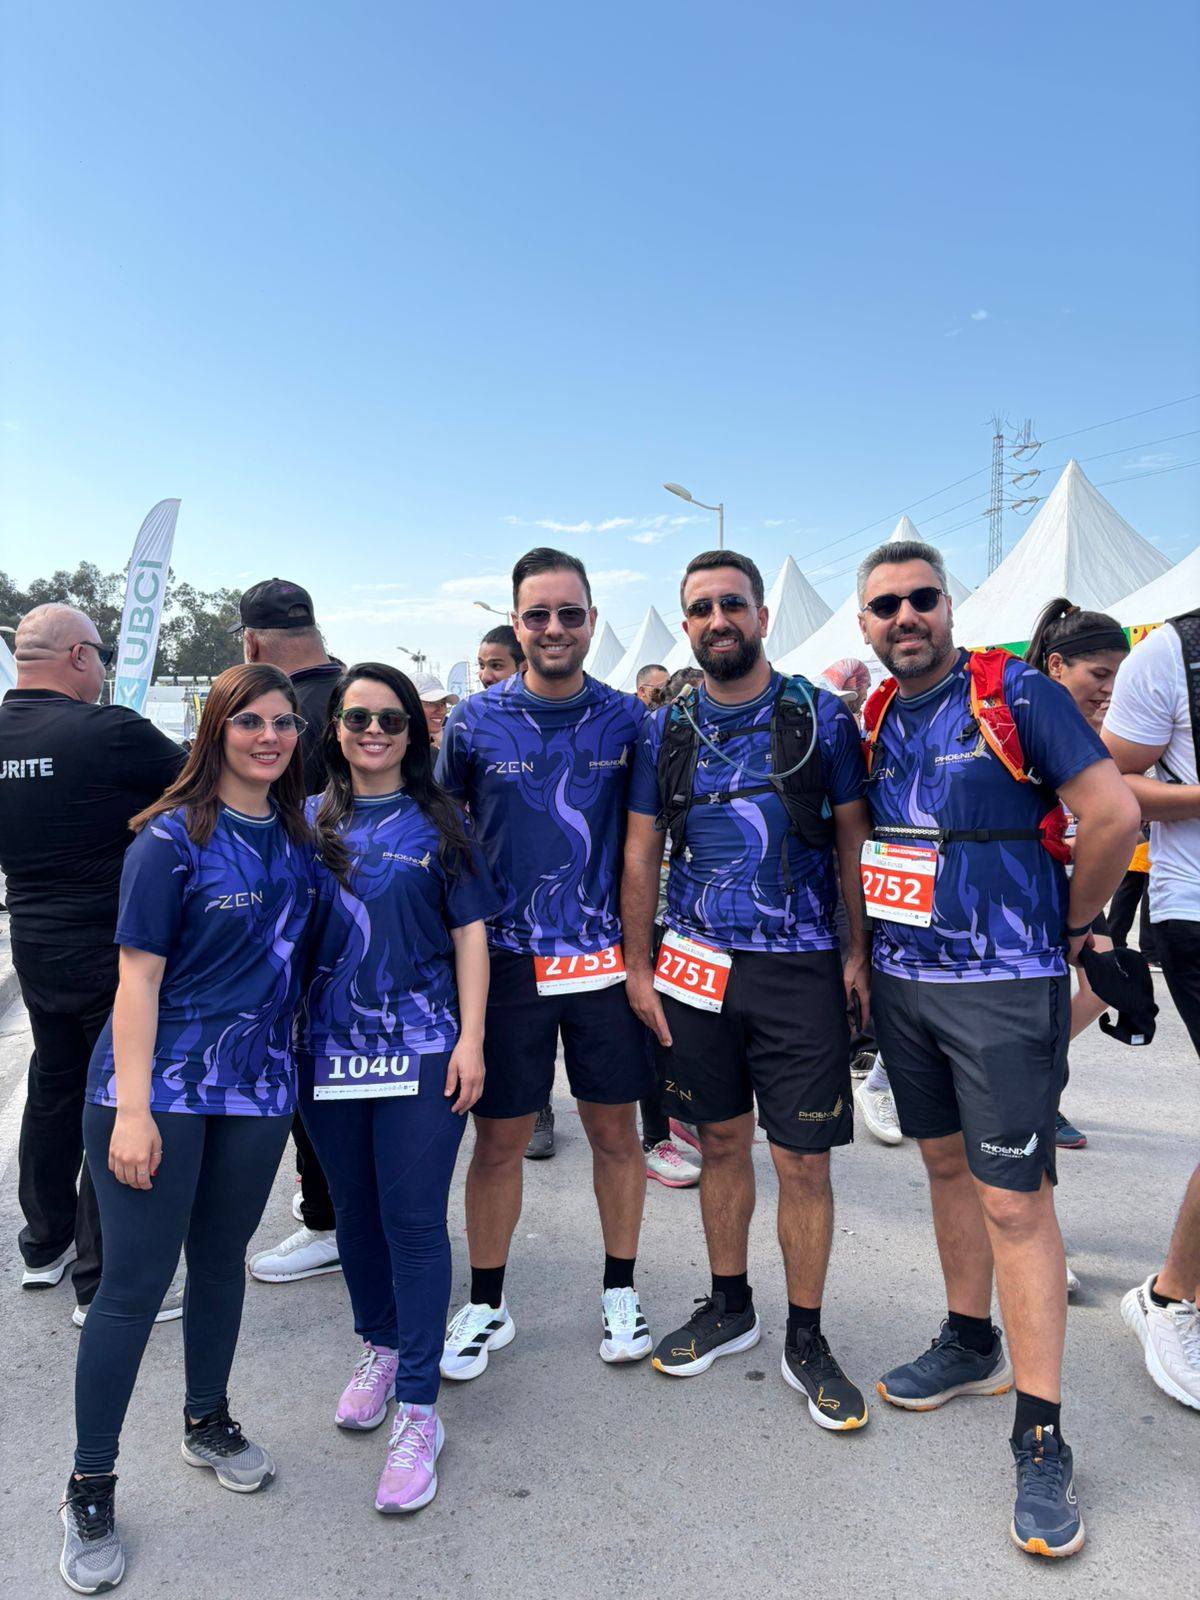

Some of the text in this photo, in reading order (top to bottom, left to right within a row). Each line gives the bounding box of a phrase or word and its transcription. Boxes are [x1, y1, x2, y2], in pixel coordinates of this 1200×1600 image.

[123, 560, 163, 665] UBCI
[495, 761, 534, 773] ZEN
[934, 751, 975, 764] PHOENIX
[862, 870, 922, 905] 2752
[218, 890, 263, 910] ZEN
[544, 946, 617, 976] 2753
[659, 951, 717, 993] 2751
[328, 1055, 410, 1079] 1040
[665, 1079, 692, 1101] ZN
[980, 1142, 1024, 1155] PHOENIX
